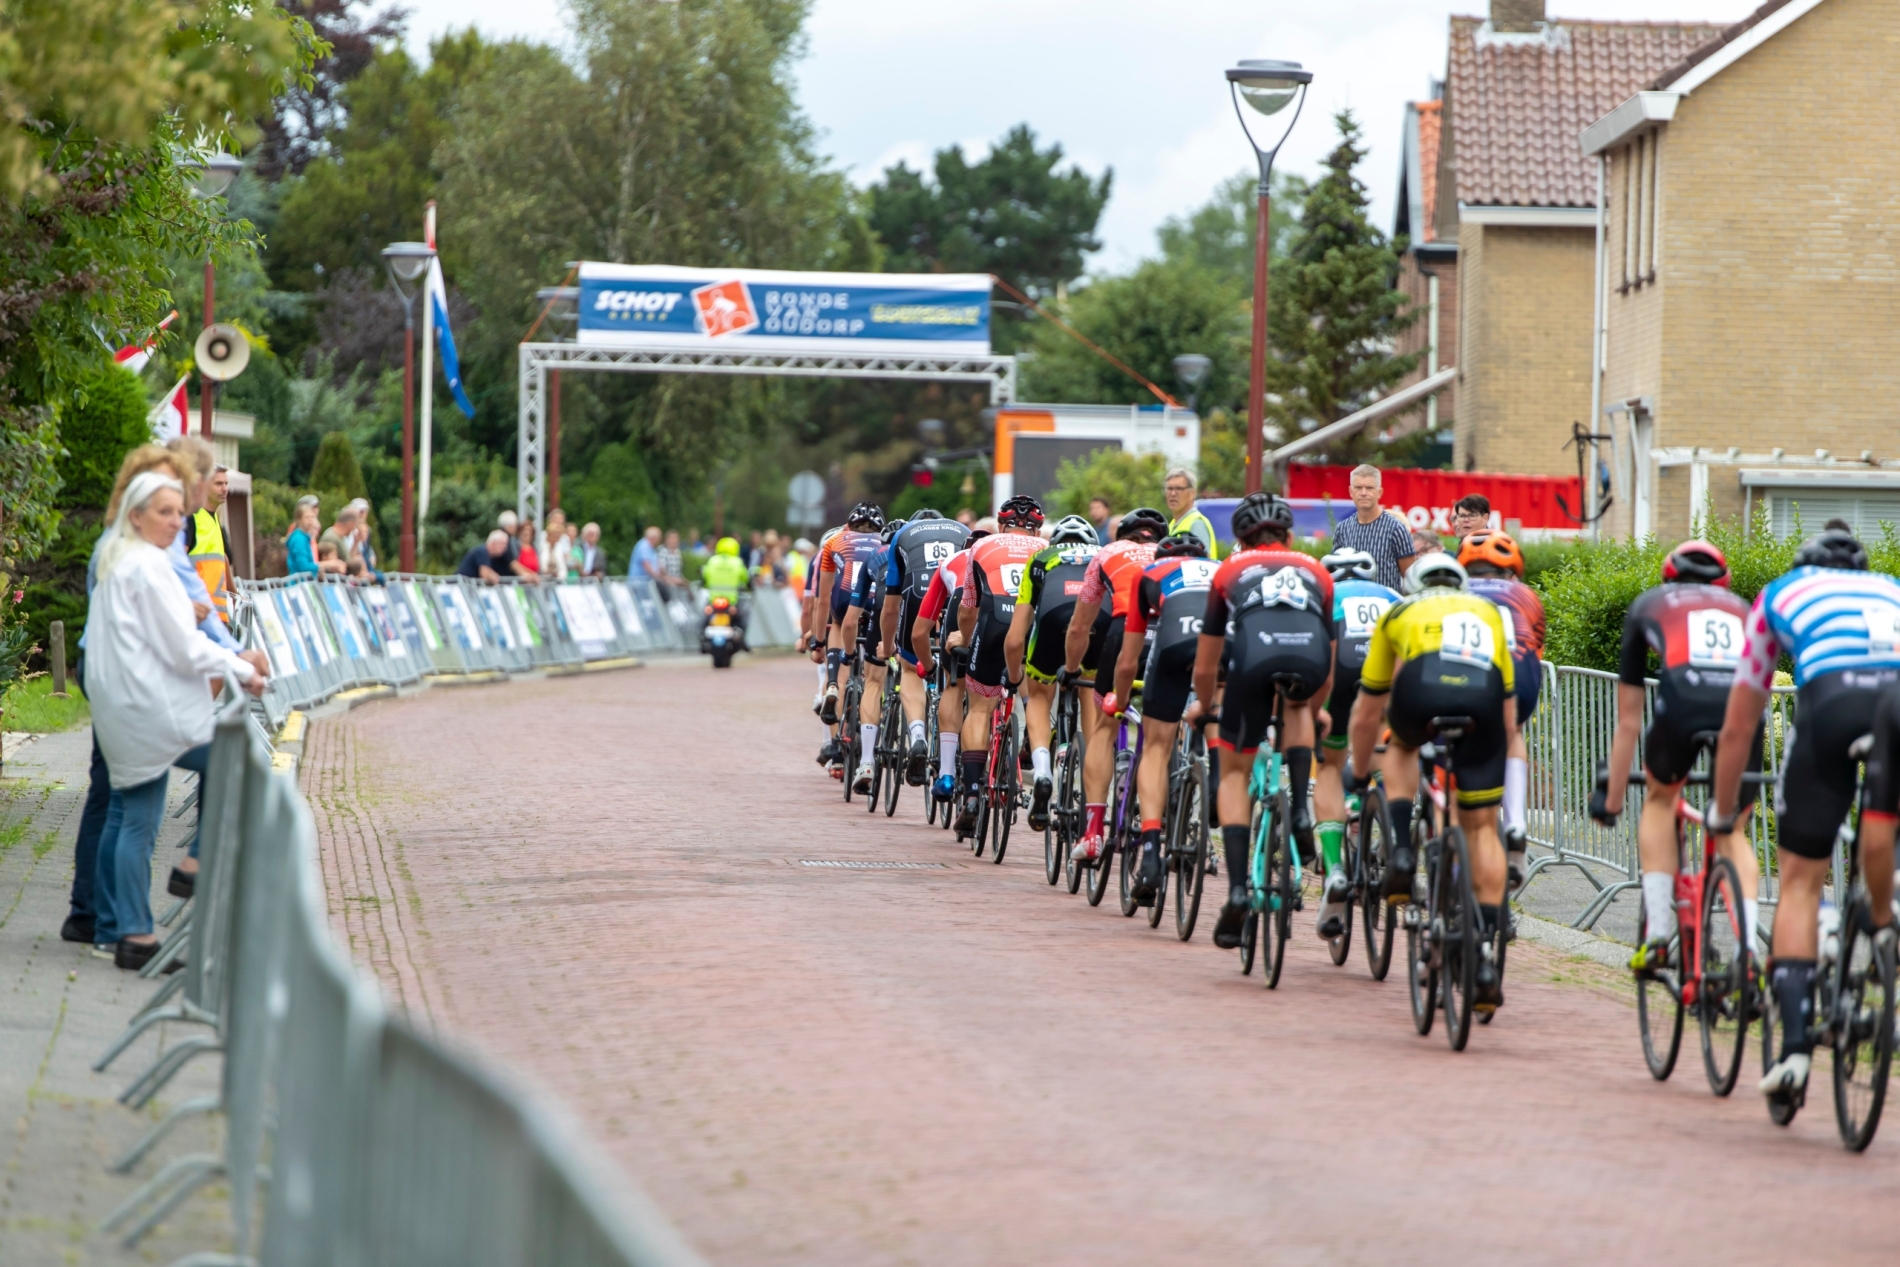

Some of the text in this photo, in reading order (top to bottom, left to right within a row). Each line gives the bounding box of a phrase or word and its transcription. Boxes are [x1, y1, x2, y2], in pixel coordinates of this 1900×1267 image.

[594, 290, 682, 312] SCHOT
[932, 544, 949, 559] 85
[1357, 603, 1380, 625] 60
[1460, 621, 1481, 648] 13
[1705, 620, 1731, 649] 53
